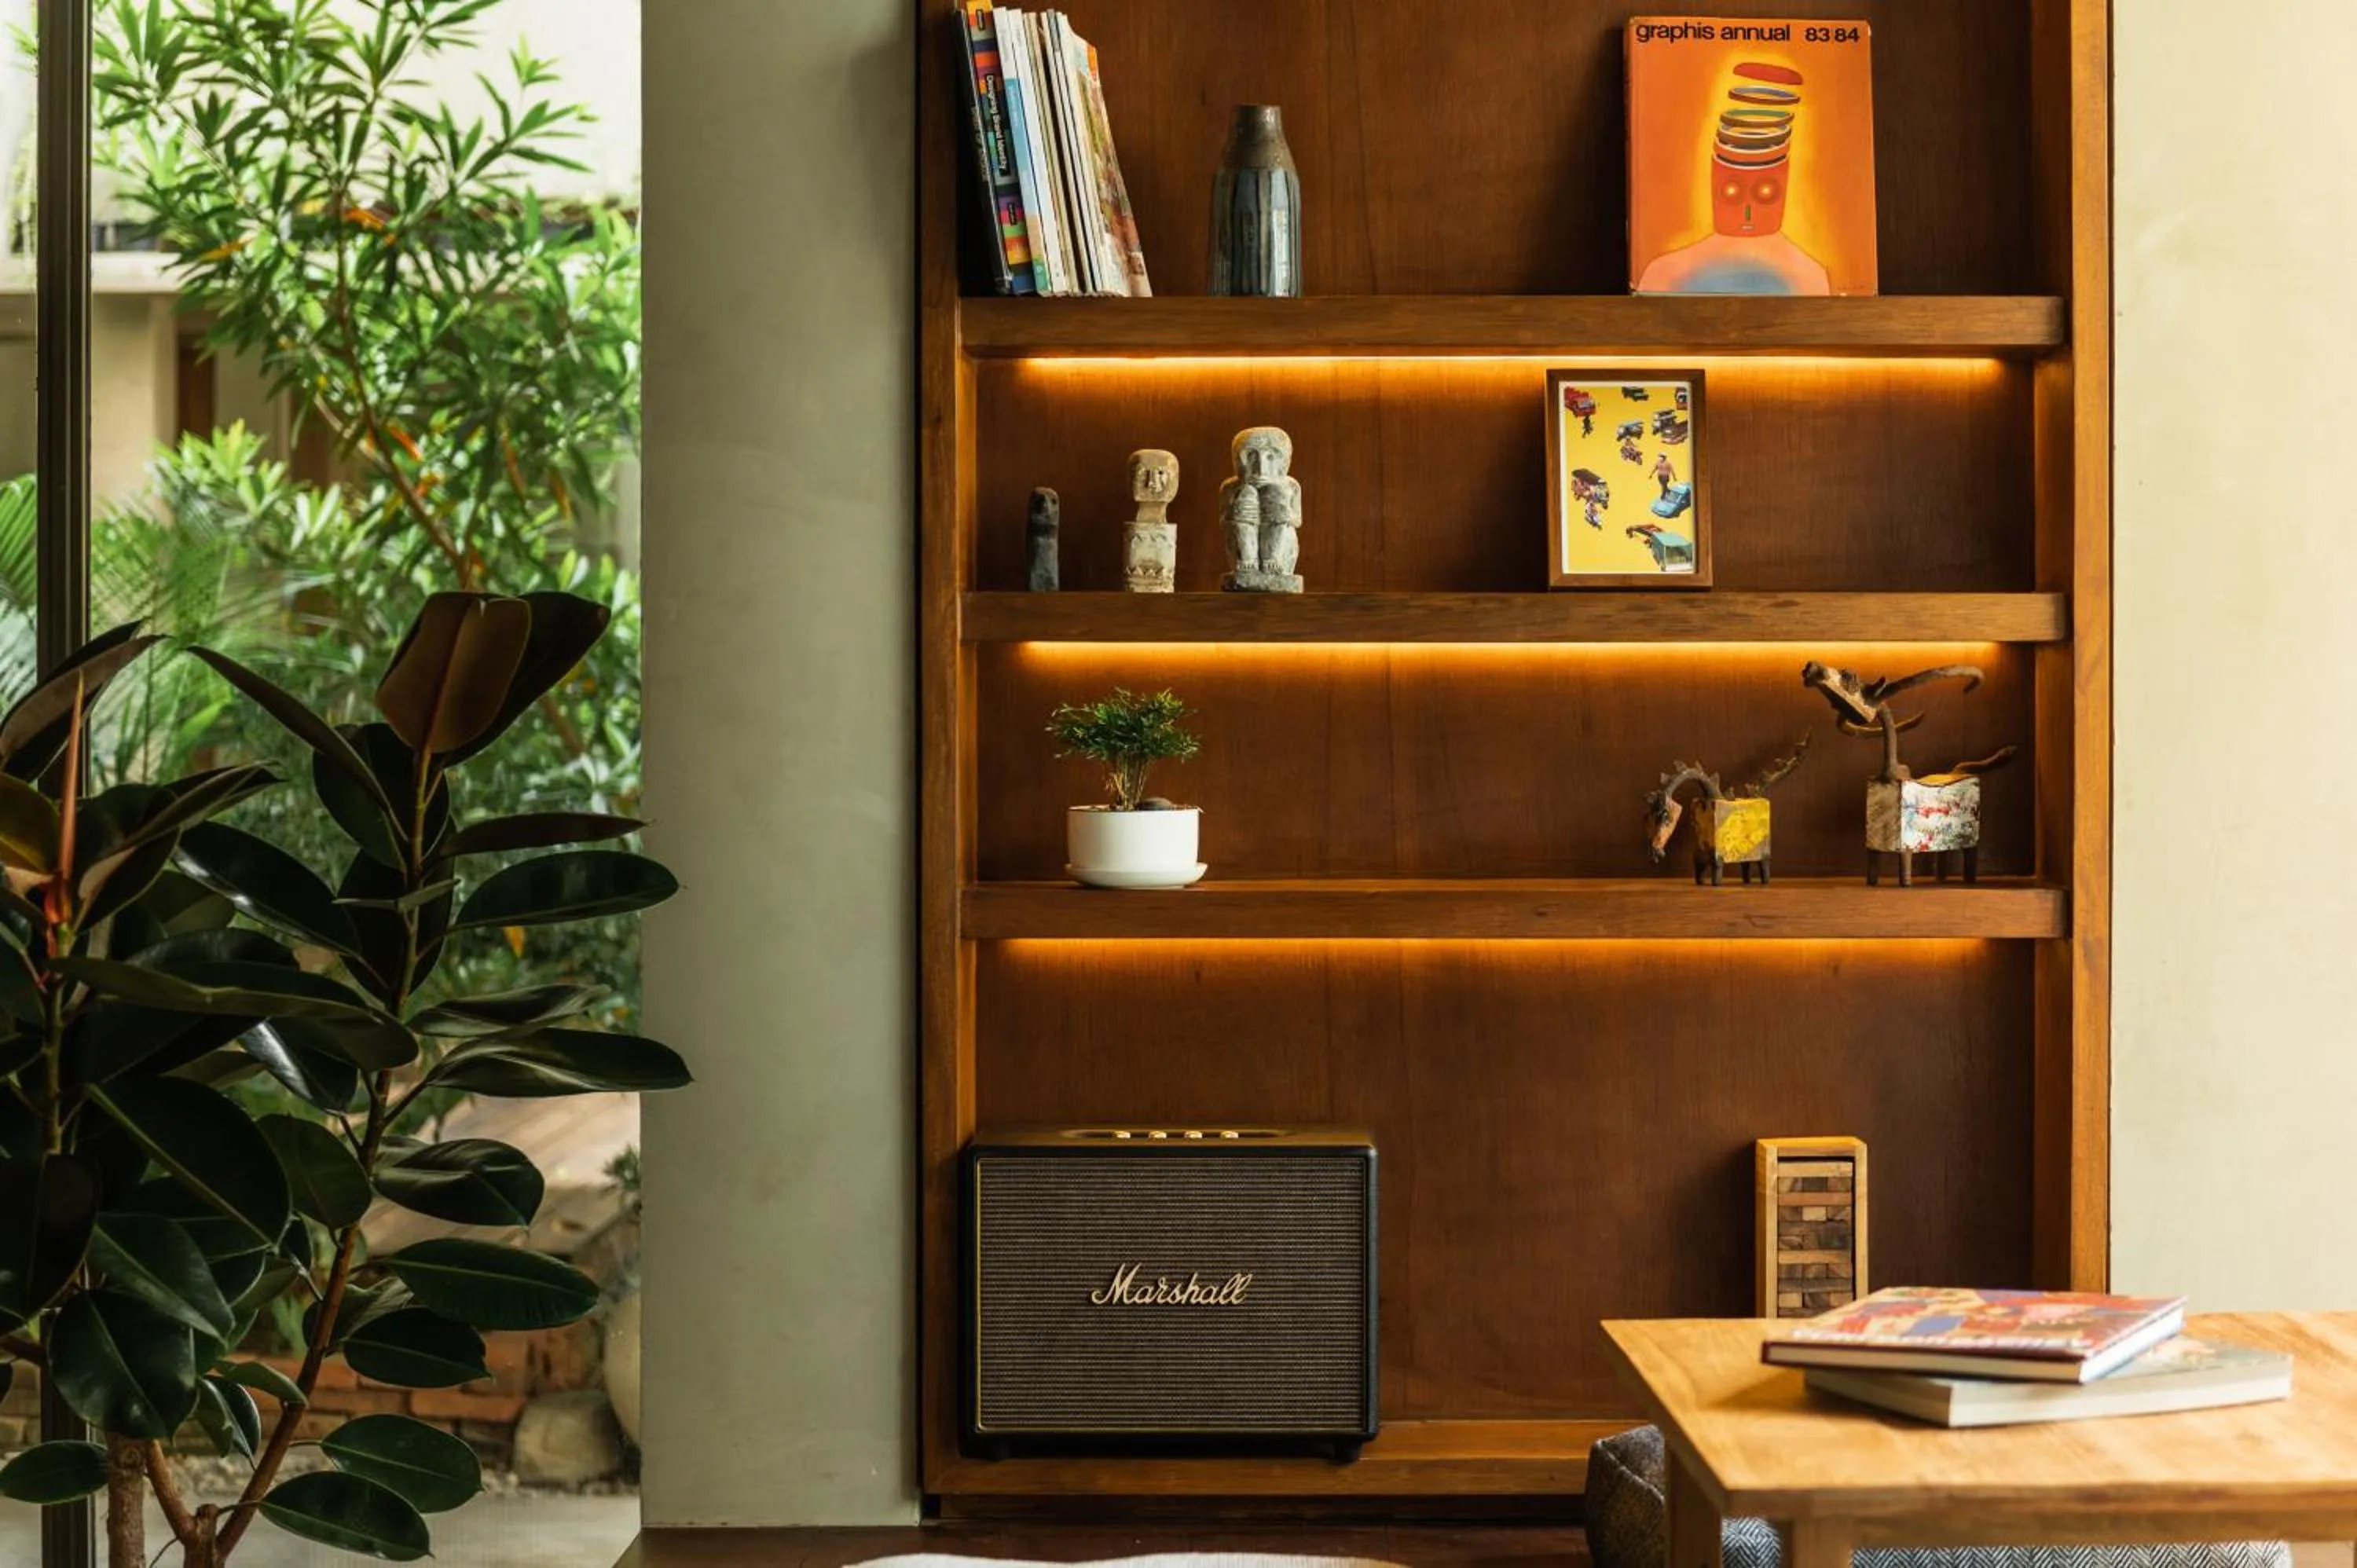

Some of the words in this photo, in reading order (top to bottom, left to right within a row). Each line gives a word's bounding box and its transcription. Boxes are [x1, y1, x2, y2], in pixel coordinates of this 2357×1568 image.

[1636, 22, 1714, 43] graphis
[1721, 24, 1790, 42] annual
[1805, 27, 1830, 42] 83
[1835, 27, 1860, 42] 84
[1091, 1262, 1252, 1305] Marshall
